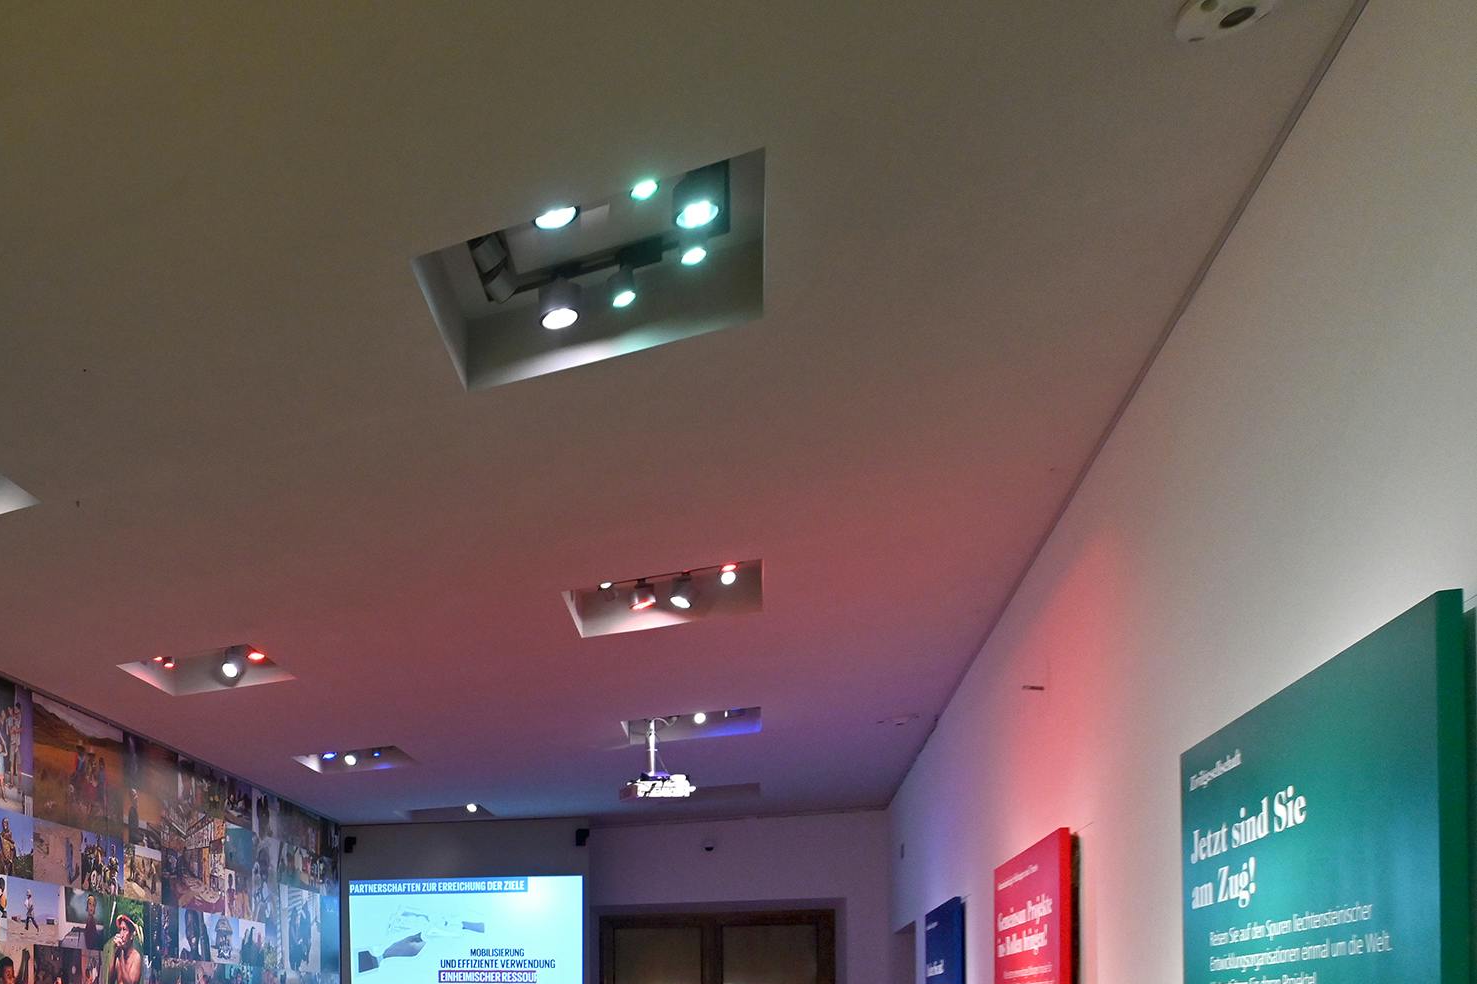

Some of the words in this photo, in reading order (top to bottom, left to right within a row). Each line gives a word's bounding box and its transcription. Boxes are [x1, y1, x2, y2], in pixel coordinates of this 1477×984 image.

[1191, 822, 1228, 864] Jetzt
[1231, 796, 1269, 848] sind
[1273, 785, 1307, 833] Sie
[349, 882, 421, 893] PARTNERSCHAFTEN
[422, 881, 437, 892] ZUR
[438, 881, 486, 892] ERREICHUNG
[487, 880, 502, 891] DER
[504, 880, 525, 890] ZIELE
[1191, 879, 1214, 910] am
[1217, 856, 1256, 908] Zug!
[470, 948, 525, 958] MOBILISIERUNG
[1301, 937, 1330, 961] einmal
[1331, 941, 1347, 958] um
[1347, 934, 1363, 956] die
[440, 959, 456, 969] UND
[457, 959, 499, 969] EFFIZIENTE
[500, 959, 556, 969] VERWENDUNG
[440, 971, 501, 982] EINHEIMISCHER
